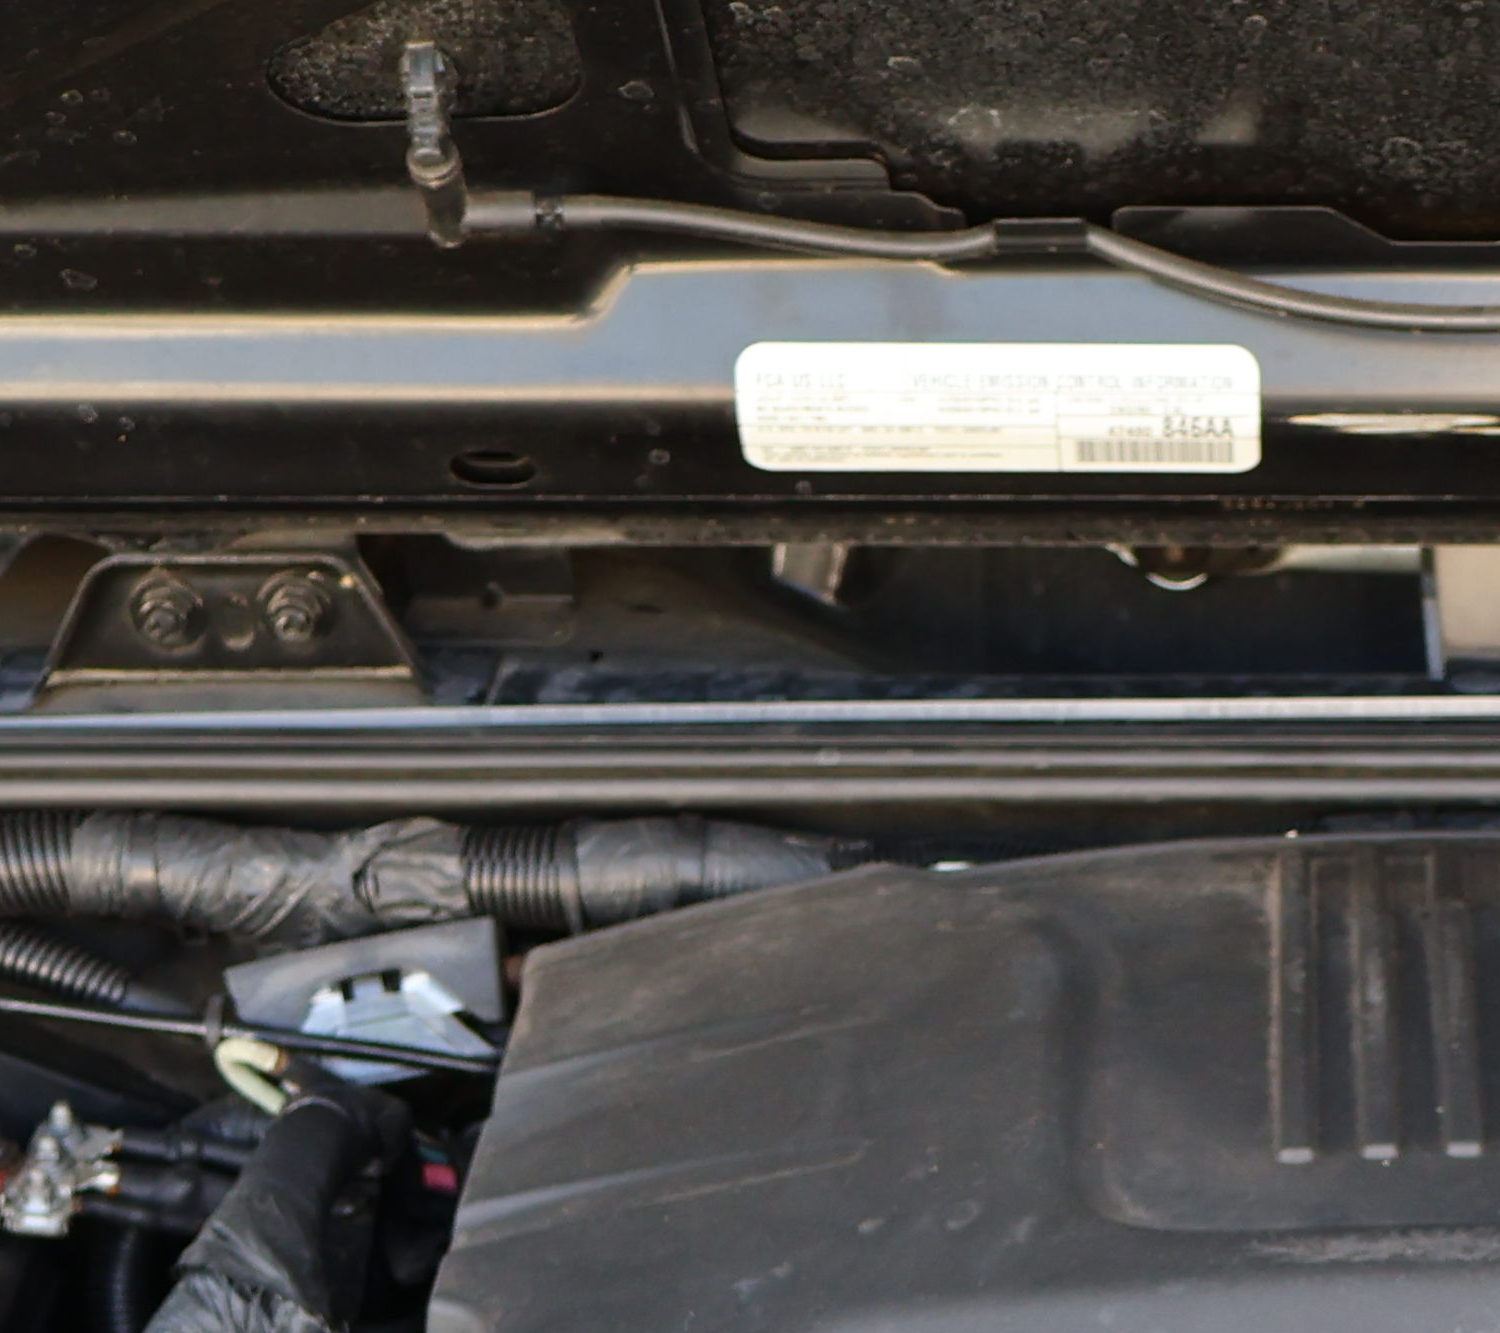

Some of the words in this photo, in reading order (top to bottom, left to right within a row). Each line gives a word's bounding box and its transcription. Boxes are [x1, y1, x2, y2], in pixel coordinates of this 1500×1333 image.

[910, 373, 971, 388] VEHICLE
[979, 373, 1049, 388] EMISSION
[1056, 375, 1120, 389] CONTROL
[1132, 375, 1233, 389] INFORMATION
